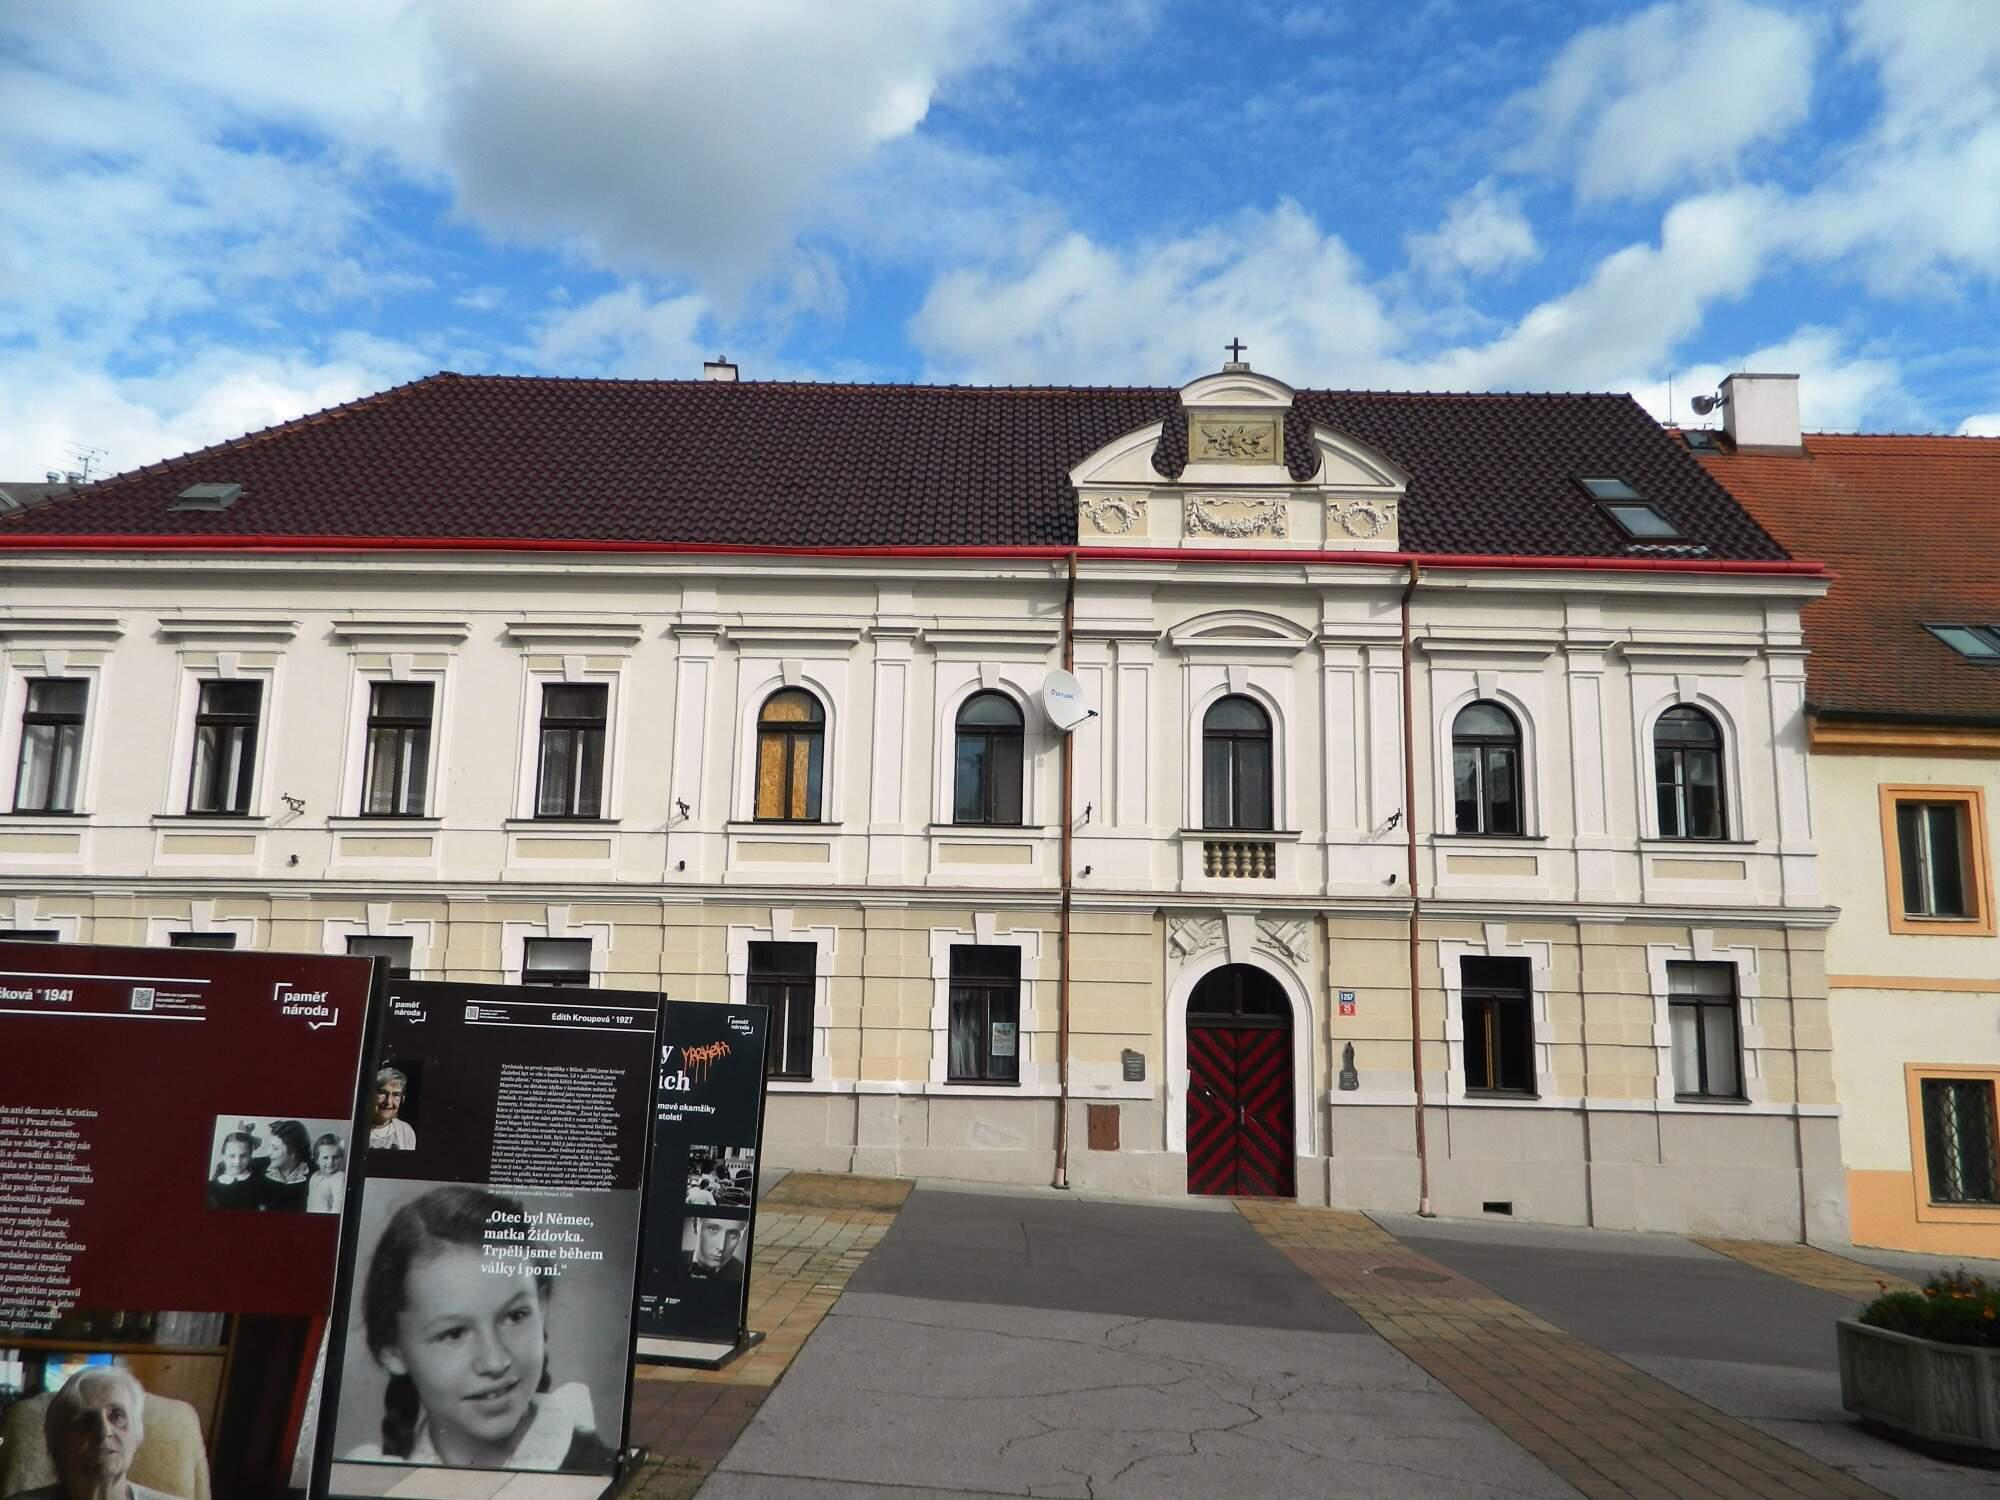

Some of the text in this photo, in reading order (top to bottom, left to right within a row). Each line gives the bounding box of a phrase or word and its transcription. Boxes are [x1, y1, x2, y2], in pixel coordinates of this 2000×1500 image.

[284, 992, 328, 1003] paměť
[395, 1001, 420, 1009] paměť
[283, 1005, 329, 1016] národa
[573, 1014, 610, 1023] Kroupová
[661, 1045, 674, 1064] y
[24, 1107, 40, 1115] den
[66, 1108, 98, 1117] Kristina
[679, 1104, 715, 1114] okamžiky
[26, 1118, 49, 1126] Praze
[658, 1113, 682, 1121] století
[486, 1211, 594, 1228] „Otec byl Němec,
[484, 1227, 584, 1242] matka Židovka.
[55, 1241, 86, 1251] Kristina
[483, 1244, 603, 1260] Trpěli jsme během
[9, 1262, 24, 1270] tam
[481, 1262, 515, 1277] války
[518, 1264, 522, 1275] i
[525, 1266, 542, 1277] po
